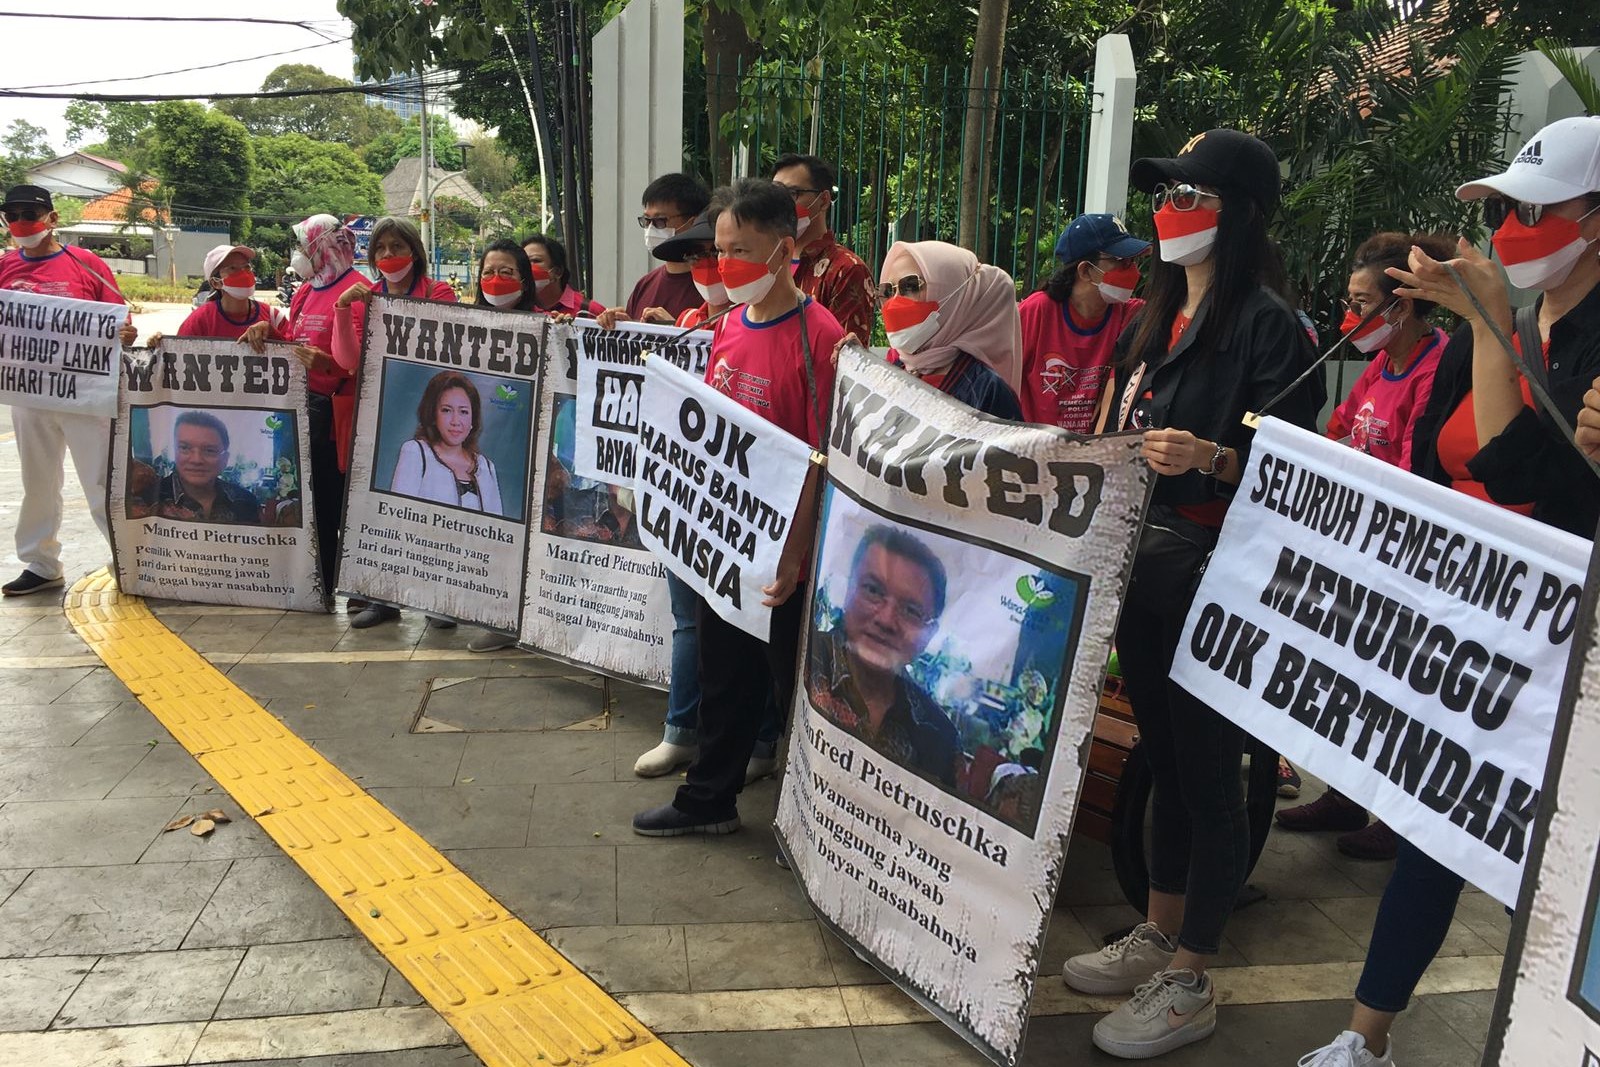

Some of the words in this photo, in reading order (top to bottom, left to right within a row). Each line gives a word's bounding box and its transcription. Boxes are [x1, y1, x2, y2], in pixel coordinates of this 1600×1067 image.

[50, 307, 93, 336] KAMI
[97, 313, 117, 339] YG
[382, 313, 540, 376] WANTED
[10, 335, 60, 364] HIDUP
[63, 341, 112, 371] LAYAK
[123, 352, 290, 395] WANTED
[49, 371, 77, 400] TUA
[679, 397, 756, 479] OJK
[830, 374, 1105, 538] WANTED
[639, 421, 706, 486] HARUS
[709, 469, 787, 543] BANTU
[377, 501, 428, 525] Evelina
[432, 513, 514, 544] Pietruschka
[642, 456, 696, 513] KAMI
[698, 497, 757, 563] PARA
[136, 545, 172, 558] Pemilik
[173, 549, 237, 564] Wanaartha
[240, 557, 269, 567] yang
[143, 523, 198, 541] Manfred
[204, 529, 297, 546] Pietruschka
[360, 523, 401, 541] Pemilik
[405, 532, 461, 555] Wanaartha
[463, 548, 490, 564] yang
[546, 543, 611, 568] Manfred
[641, 492, 742, 611] LANSIA
[1250, 453, 1364, 546] SELURUH
[1359, 497, 1529, 622] PEMEGANG
[136, 559, 154, 569] lari
[155, 561, 176, 572] dari
[180, 565, 232, 578] tanggung
[234, 568, 270, 579] jawab
[356, 555, 378, 567] atas
[381, 560, 409, 576] gagal
[412, 566, 443, 583] bayar
[446, 575, 509, 599] nasabahnya
[358, 539, 378, 552] lari
[380, 544, 402, 557] dari
[405, 550, 454, 572] tanggung
[455, 561, 488, 578] jawab
[138, 572, 156, 583] atas
[159, 576, 188, 587] gagal
[192, 579, 224, 590] bayar
[226, 582, 295, 596] nasabahnya
[539, 586, 553, 600] lari
[554, 591, 577, 606] dari
[580, 596, 620, 619] tanggung
[620, 608, 645, 622] jawab
[540, 569, 577, 588] Pemilik
[580, 578, 628, 599] Wanaartha
[628, 591, 647, 606] yang
[538, 605, 554, 619] atas
[555, 612, 583, 627] gagal
[586, 613, 610, 633] bayar
[611, 625, 664, 646] nasabahnya
[1259, 546, 1534, 731] MENUNGGU
[1191, 602, 1270, 690] OJK
[1261, 643, 1541, 865] BERTINDAK
[813, 772, 902, 846] Wanaartha
[905, 839, 952, 883] yang
[859, 756, 1009, 867] Pietruschka
[813, 804, 887, 871] tanggung
[887, 856, 944, 907] jawab
[817, 837, 864, 883] bayar
[867, 876, 977, 964] nasabahnya
